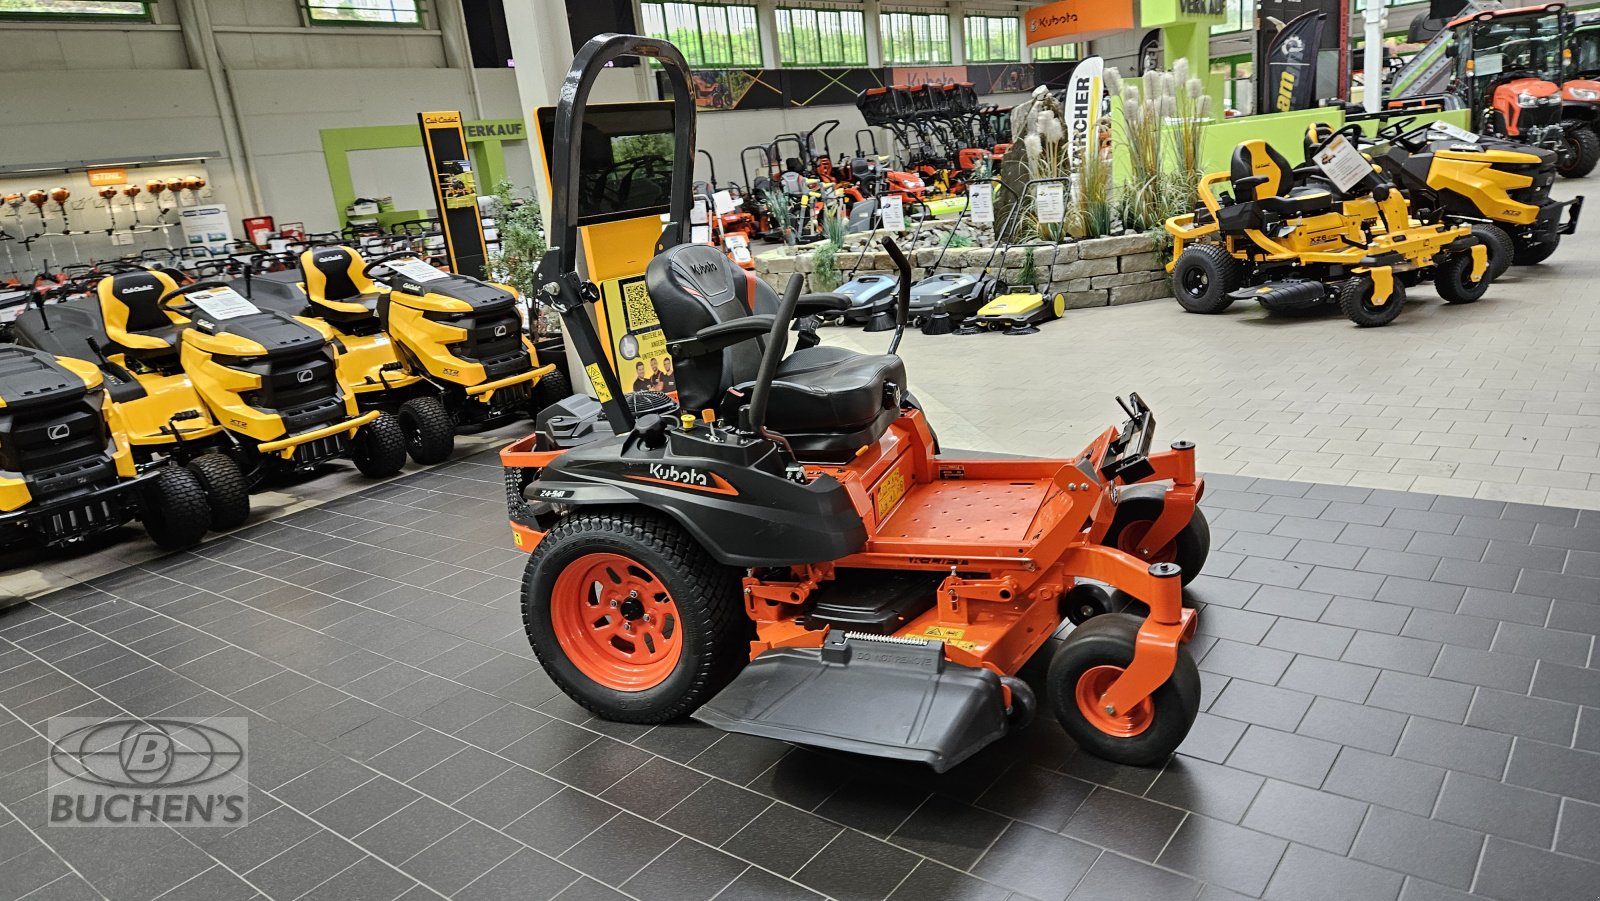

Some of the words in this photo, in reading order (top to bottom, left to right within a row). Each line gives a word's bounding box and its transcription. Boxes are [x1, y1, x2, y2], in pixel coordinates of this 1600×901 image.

[1039, 12, 1078, 28] Kubota
[464, 123, 522, 137] ERKAUF
[649, 463, 707, 486] Kubota
